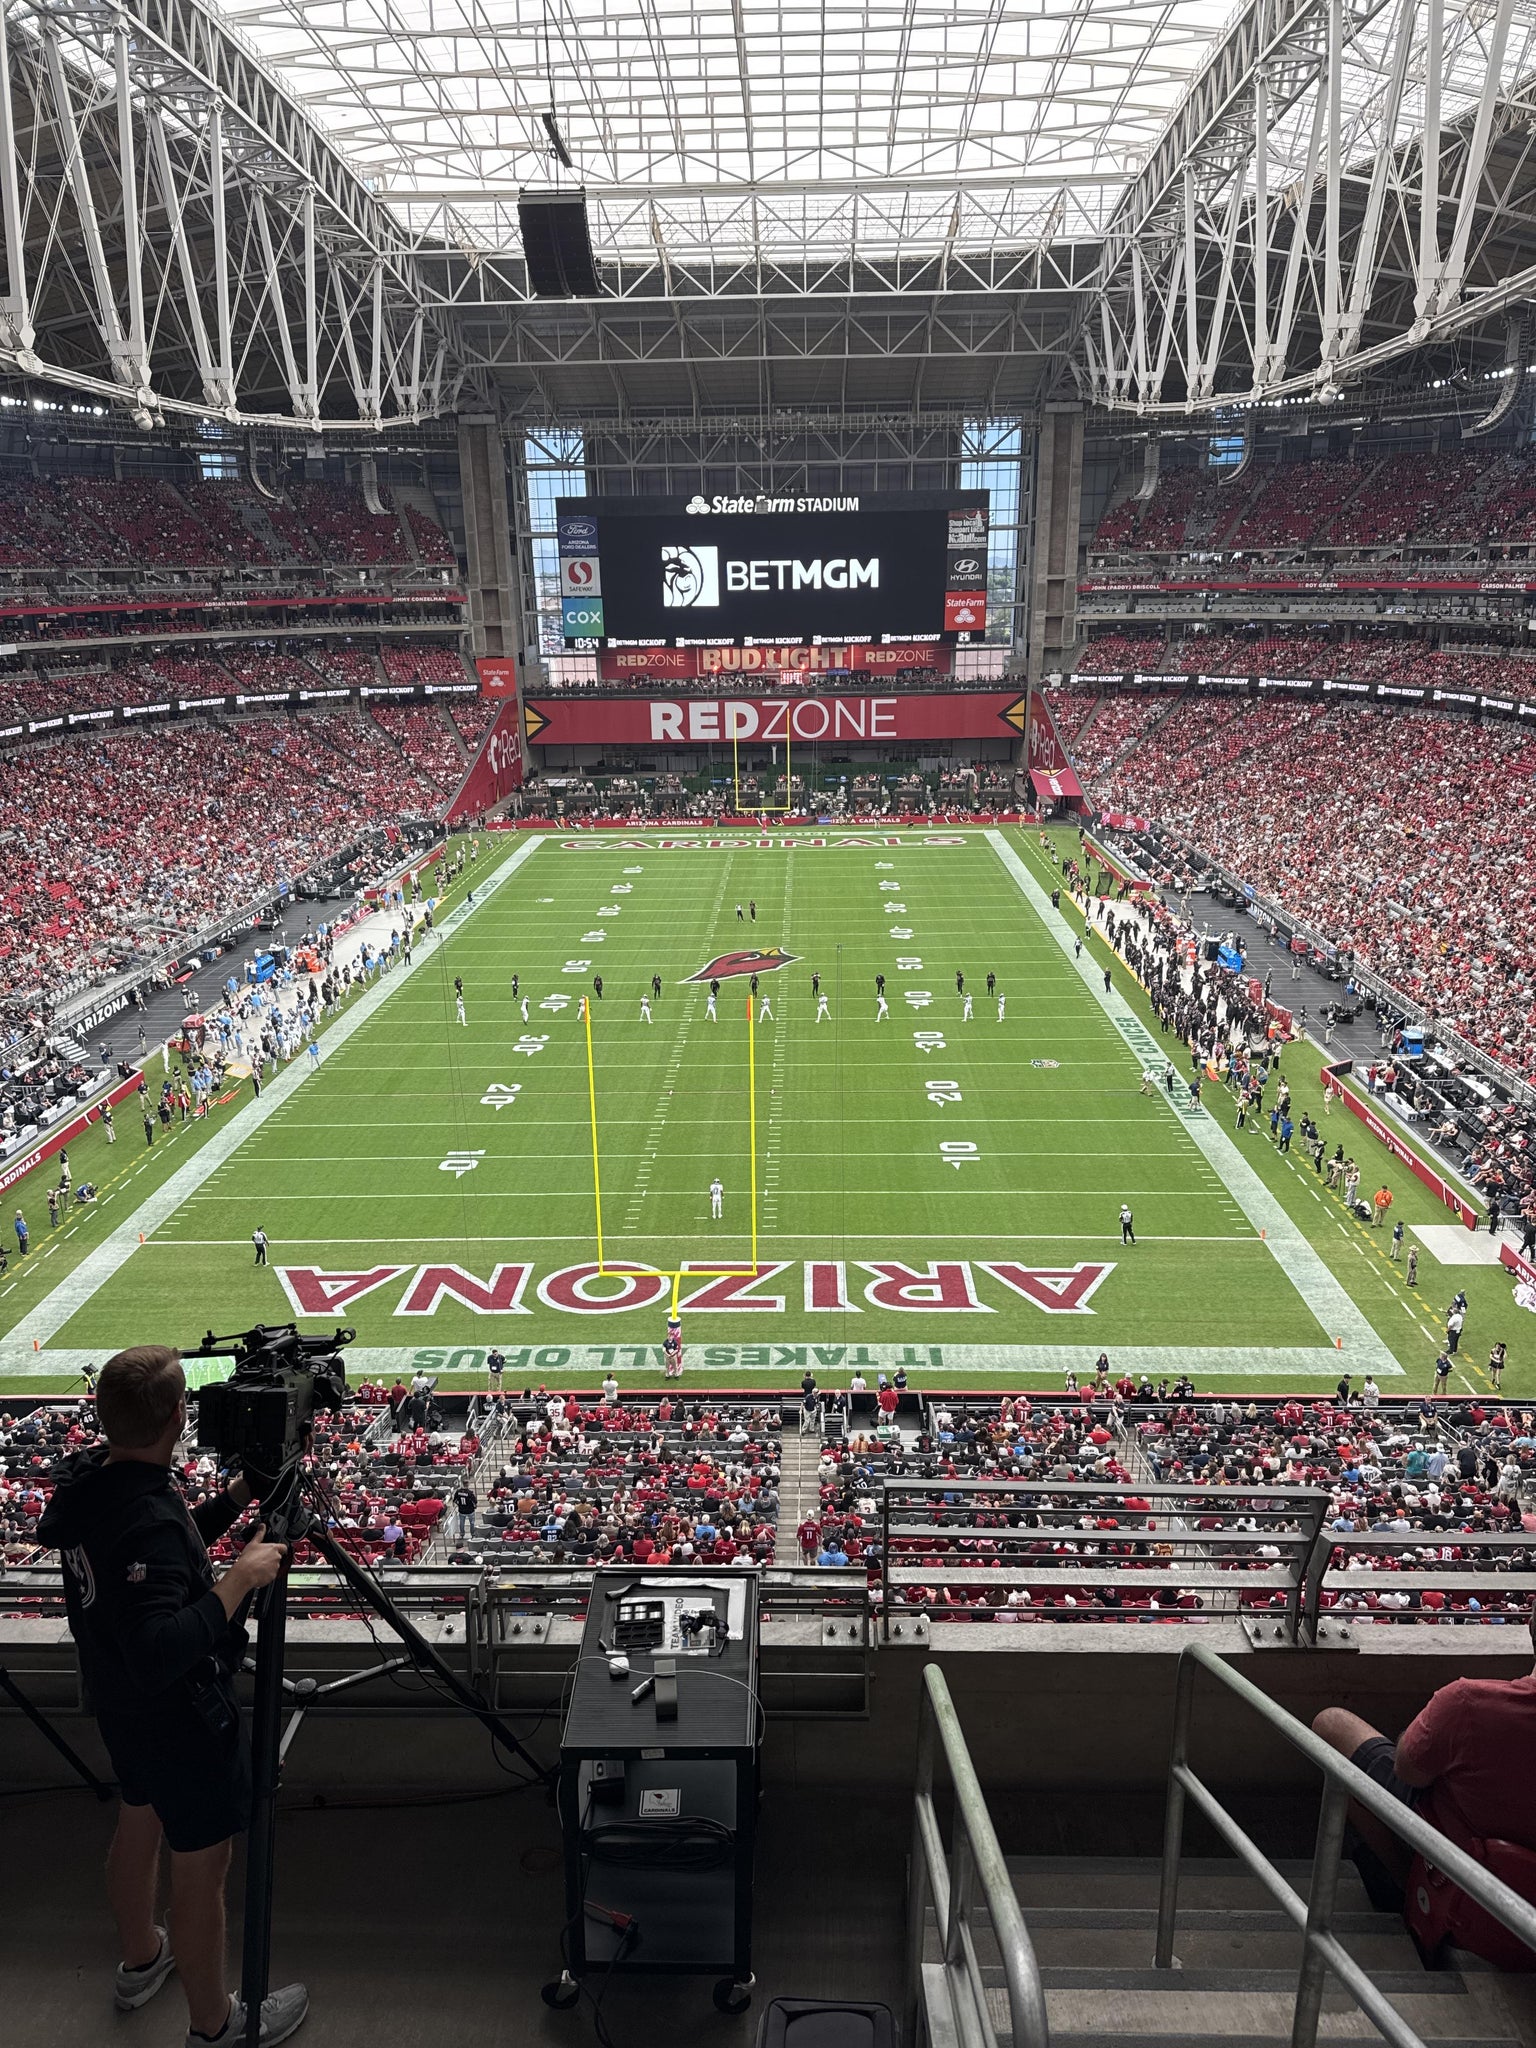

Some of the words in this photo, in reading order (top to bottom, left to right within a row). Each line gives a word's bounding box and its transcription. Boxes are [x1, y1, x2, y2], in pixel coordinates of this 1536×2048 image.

[797, 497, 859, 512] STADIUM
[567, 524, 588, 534] Ford
[726, 558, 879, 591] BETMGM
[566, 612, 600, 624] COX
[574, 638, 599, 648] 10:54
[616, 654, 685, 666] REDZONE
[703, 648, 762, 670] BUD
[766, 647, 847, 669] LIGHT
[866, 650, 934, 662] REDZONE
[650, 698, 897, 740] REDZONE
[560, 836, 968, 850] CARDINALS
[561, 960, 592, 973] 50
[896, 957, 924, 970] 50
[539, 993, 572, 1009] 40
[904, 991, 934, 1006] 40
[76, 995, 129, 1038] ARIZONA
[512, 1034, 550, 1052] 30
[913, 1031, 947, 1049] 30
[1115, 1017, 1158, 1054] CANCER
[480, 1083, 523, 1105] 20
[924, 1080, 963, 1102] 20
[1143, 1057, 1209, 1120] INTERCPT
[438, 1149, 486, 1171] 10
[939, 1142, 981, 1162] 10
[272, 1260, 1118, 1318] ARIZONA
[411, 1349, 486, 1370] US
[504, 1348, 571, 1368] OF
[704, 1347, 880, 1366] TAKES
[894, 1347, 943, 1366] IT
[362, 1390, 370, 1398] 18
[83, 1414, 94, 1423] 40
[504, 1504, 514, 1513] 10
[674, 1597, 684, 1623] VIDEO
[670, 1626, 680, 1649] TEAM
